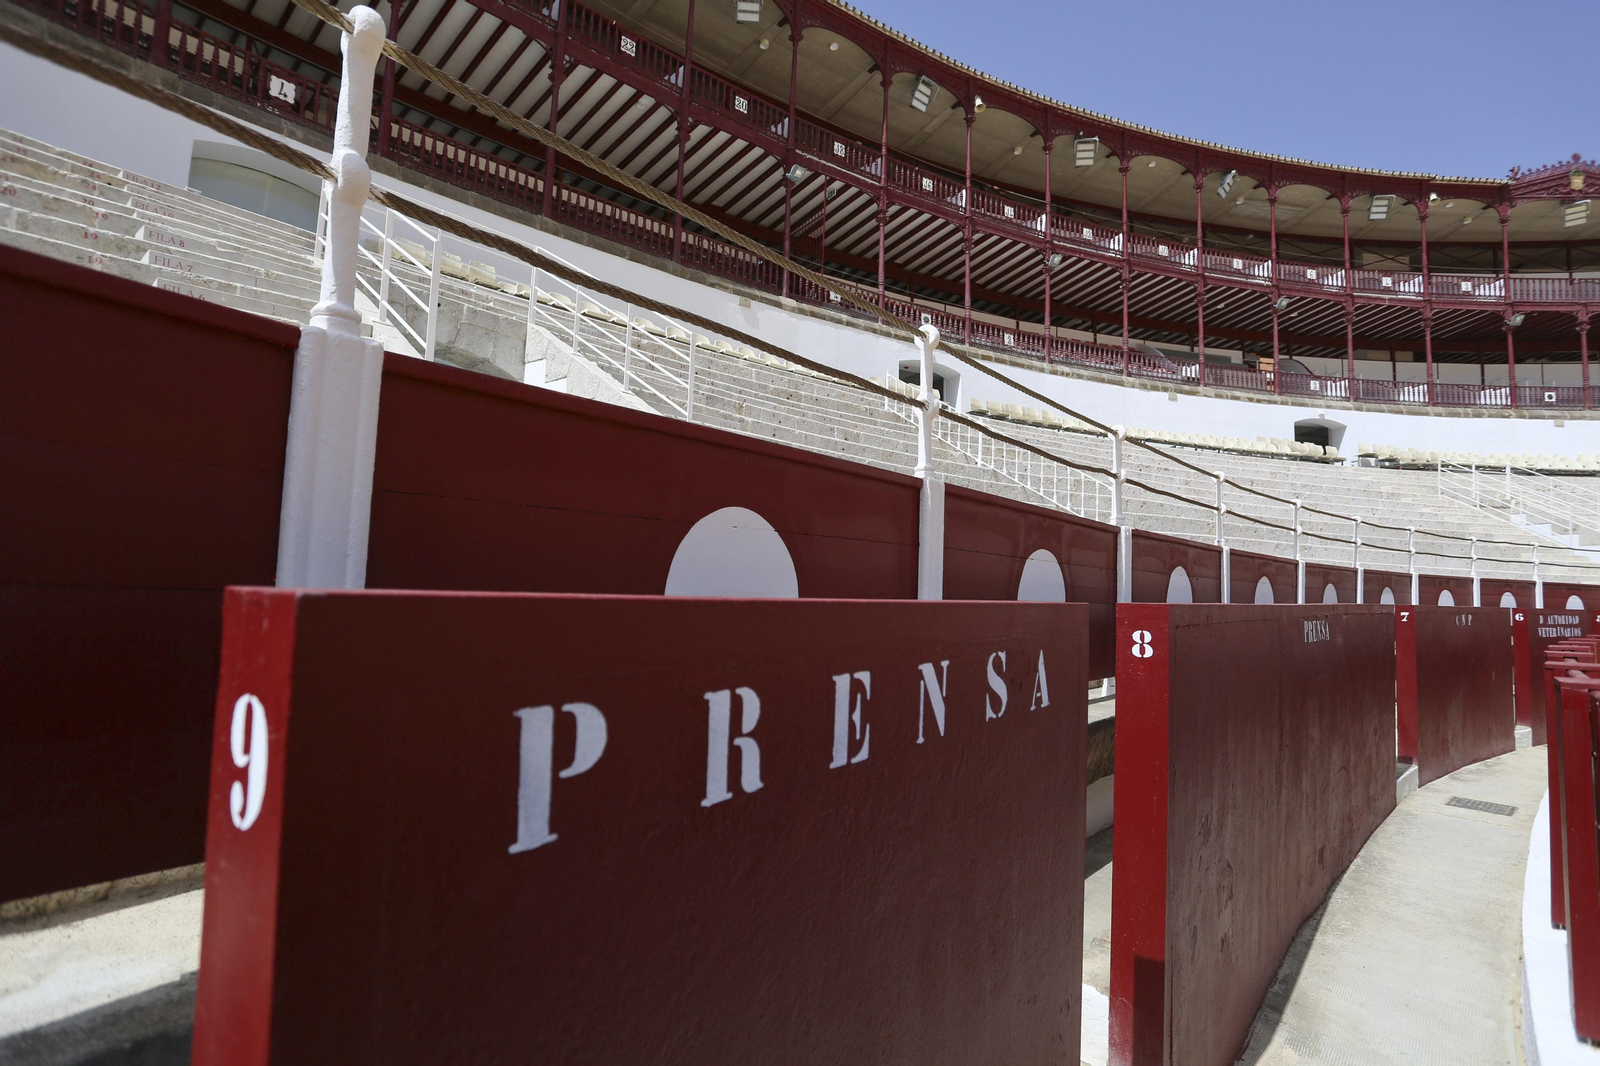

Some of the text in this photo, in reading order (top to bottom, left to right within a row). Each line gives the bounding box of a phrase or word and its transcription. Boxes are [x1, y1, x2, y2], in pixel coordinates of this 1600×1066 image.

[621, 38, 636, 54] 22
[277, 81, 288, 99] 4
[735, 97, 748, 111] 20
[835, 143, 845, 155] 18
[83, 181, 97, 191] 24
[94, 211, 109, 220] 19
[83, 231, 98, 240] 19
[149, 229, 176, 245] FILA
[87, 255, 103, 265] 19
[154, 255, 184, 270] FILA
[1400, 611, 1410, 622] 7
[1515, 612, 1525, 622] 6
[1546, 614, 1580, 625] AUTORIDAD
[1303, 620, 1330, 643] PRENSA
[1537, 626, 1582, 638] VETERINARIOS
[1131, 629, 1154, 658] 8
[507, 649, 1051, 854] PRENSA
[229, 692, 269, 831] 9
